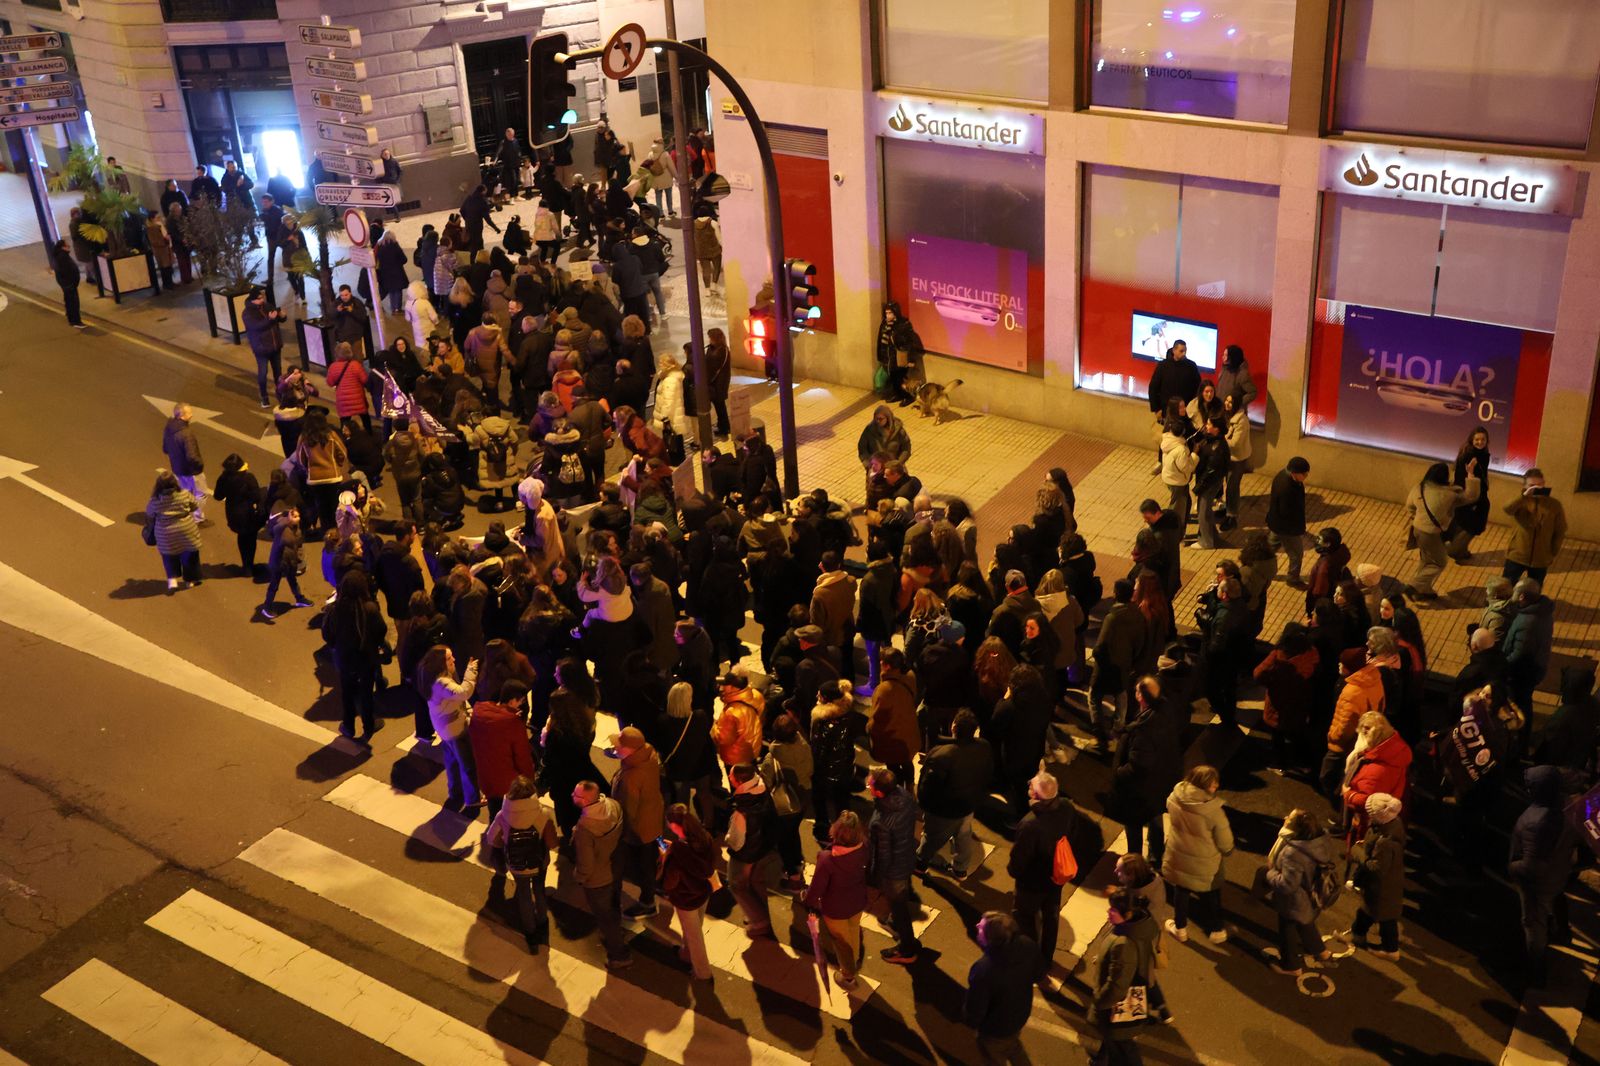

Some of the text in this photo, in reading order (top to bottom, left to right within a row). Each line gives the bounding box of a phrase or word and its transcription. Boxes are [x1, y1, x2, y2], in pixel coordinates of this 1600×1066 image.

[320, 31, 350, 42] SALAMANCA
[18, 62, 64, 72] SALAMANCA
[32, 89, 71, 99] VALLADOLID
[35, 111, 77, 121] Hospitales
[916, 112, 1022, 145] Santander
[1383, 164, 1544, 204] Santander
[319, 194, 348, 203] ORENSE
[911, 277, 1024, 311] EN SHOCK LITERAL
[1360, 348, 1496, 396] ¿HOLA?
